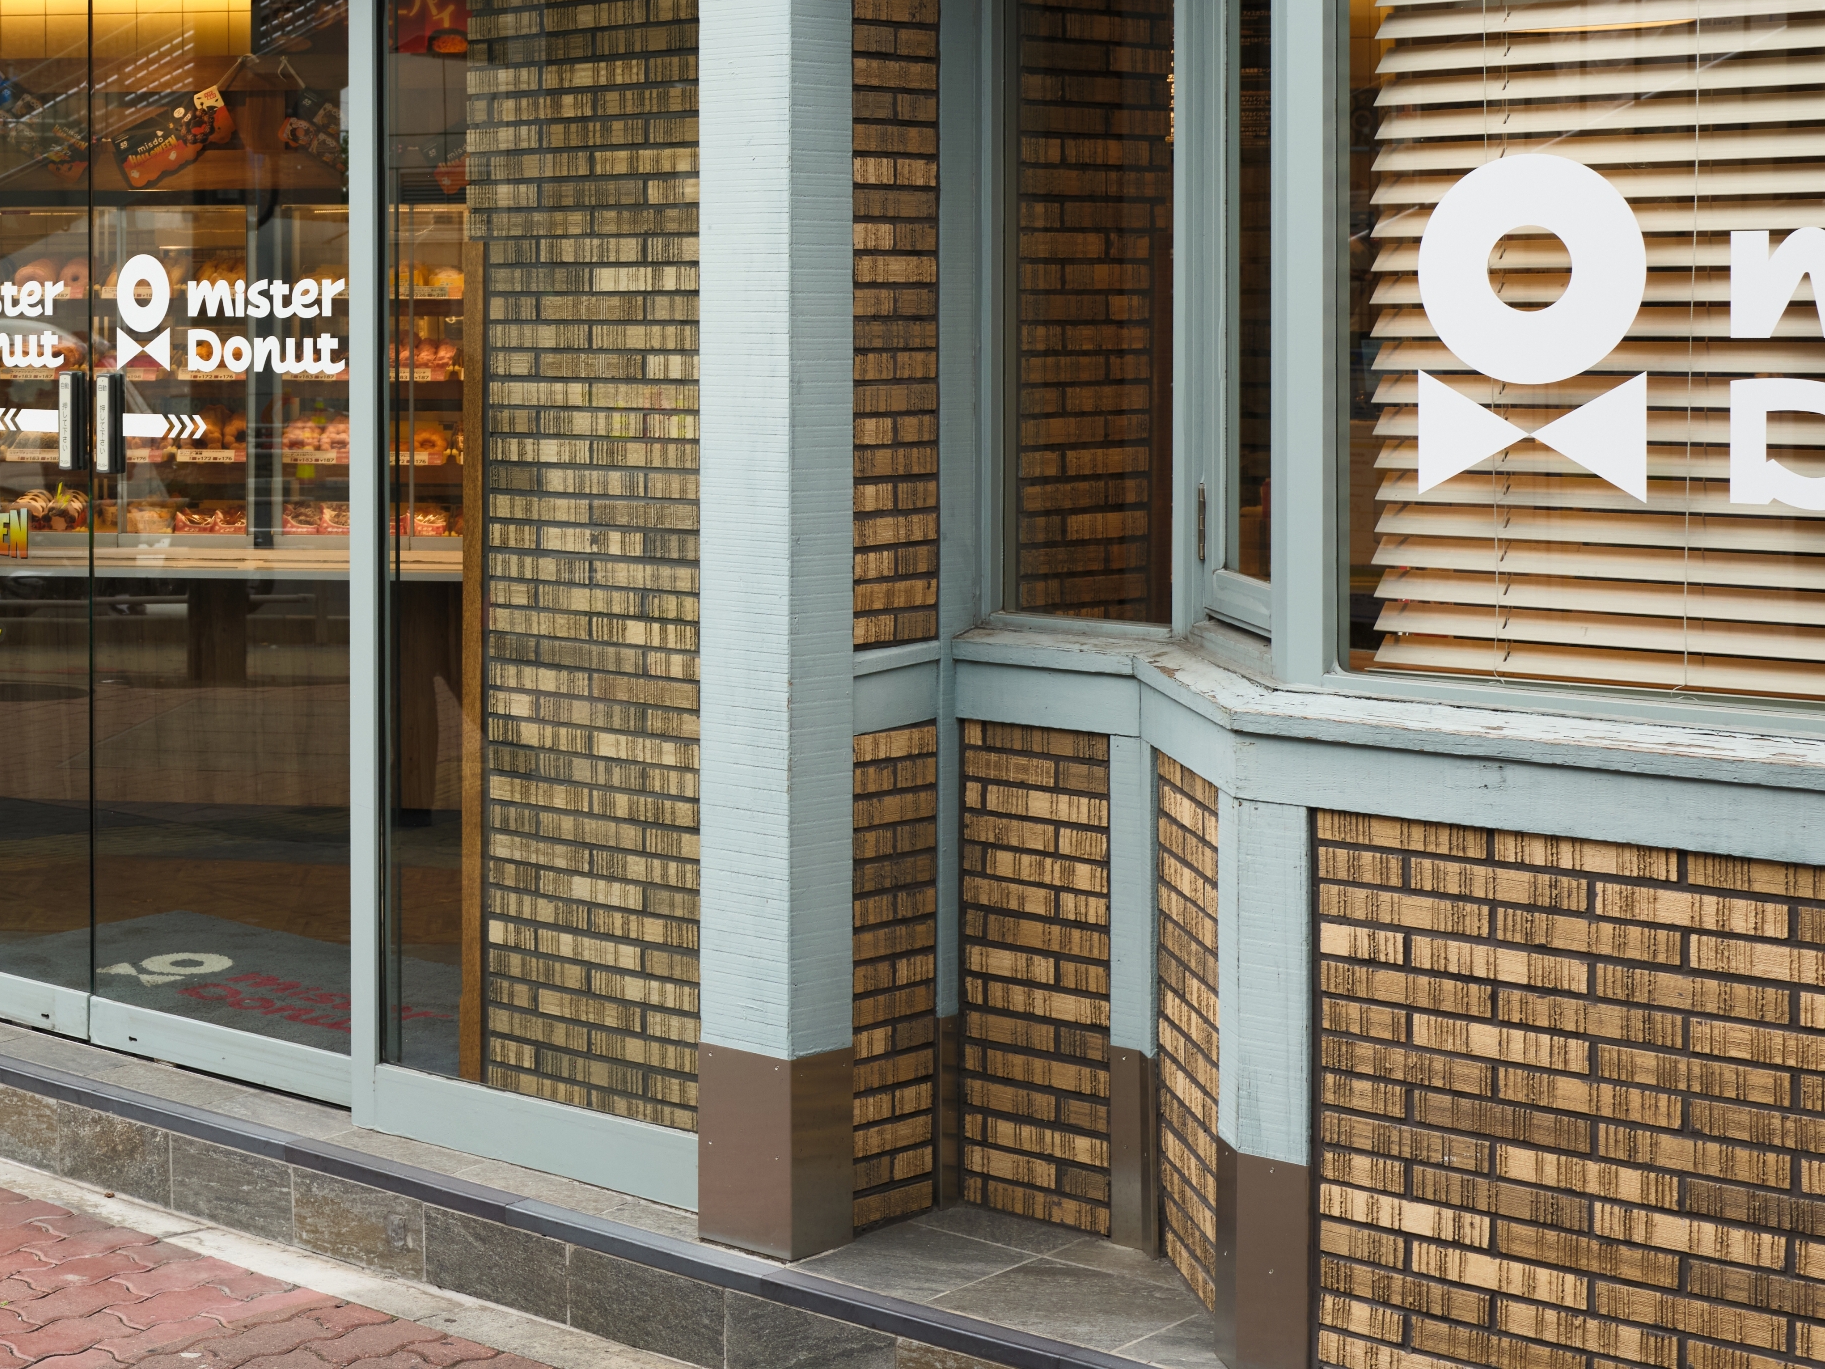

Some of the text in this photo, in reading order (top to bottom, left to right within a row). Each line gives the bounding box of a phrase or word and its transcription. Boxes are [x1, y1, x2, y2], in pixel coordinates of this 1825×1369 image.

[128, 135, 178, 166] HALLOWEEN
[137, 136, 164, 154] misdo
[187, 278, 346, 319] mister
[187, 328, 346, 375] Donut
[98, 384, 107, 392] 自動
